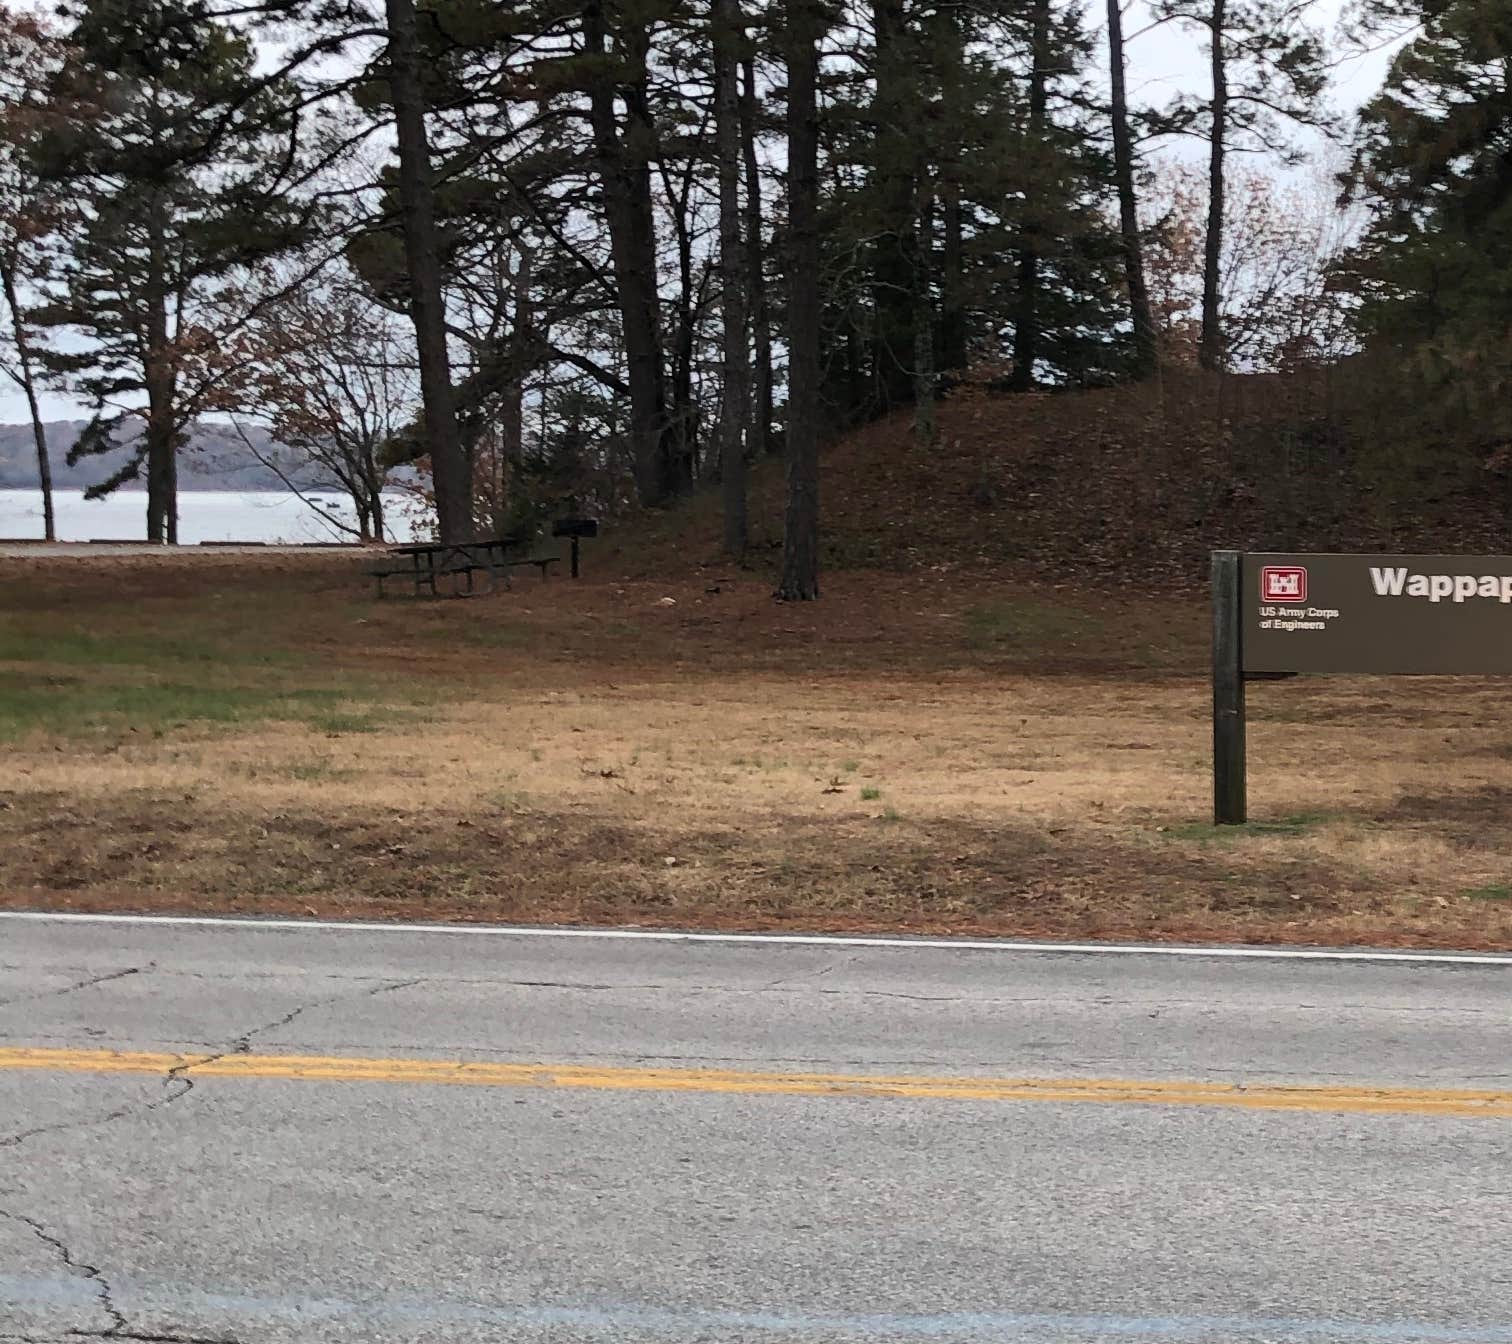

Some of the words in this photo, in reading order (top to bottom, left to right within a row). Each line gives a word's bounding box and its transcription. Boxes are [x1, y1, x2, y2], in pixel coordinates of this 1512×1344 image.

[1259, 607, 1276, 617] US
[1278, 607, 1306, 619] Army
[1307, 607, 1340, 619] Corps
[1260, 620, 1272, 629] of
[1274, 619, 1326, 631] Engineers
